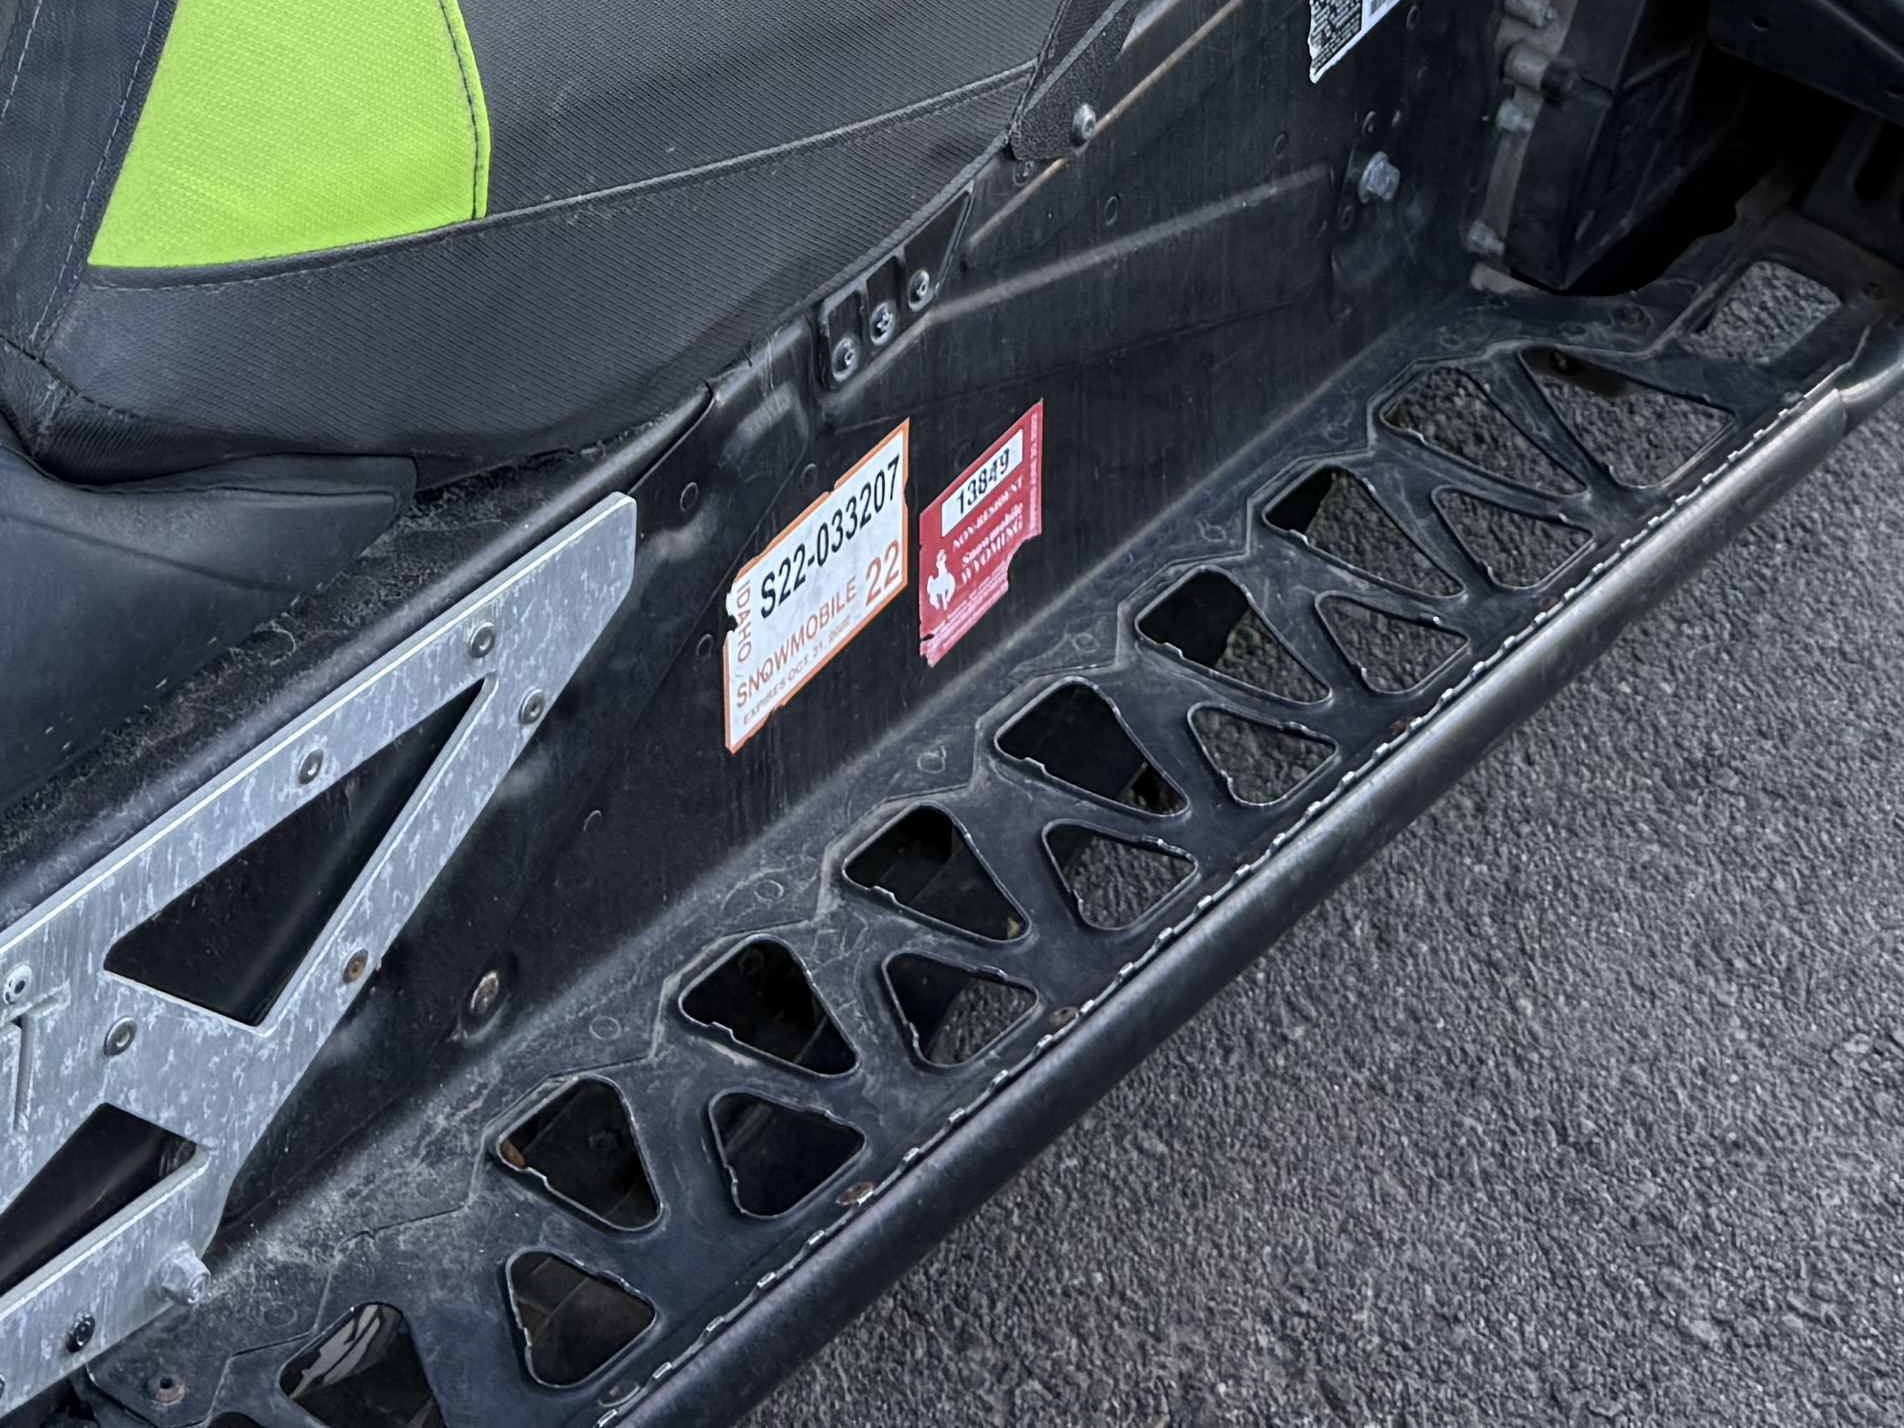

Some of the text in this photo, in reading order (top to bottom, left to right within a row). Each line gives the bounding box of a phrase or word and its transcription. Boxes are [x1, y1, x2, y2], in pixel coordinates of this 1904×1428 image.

[956, 446, 1011, 516] 13849
[760, 453, 900, 619] S22-033207
[961, 514, 1024, 584] WYOMING
[962, 502, 1024, 568] Snowmobile
[736, 579, 752, 664] IDAHO
[736, 575, 857, 708] SNOWMOBILE
[865, 538, 900, 608] 22
